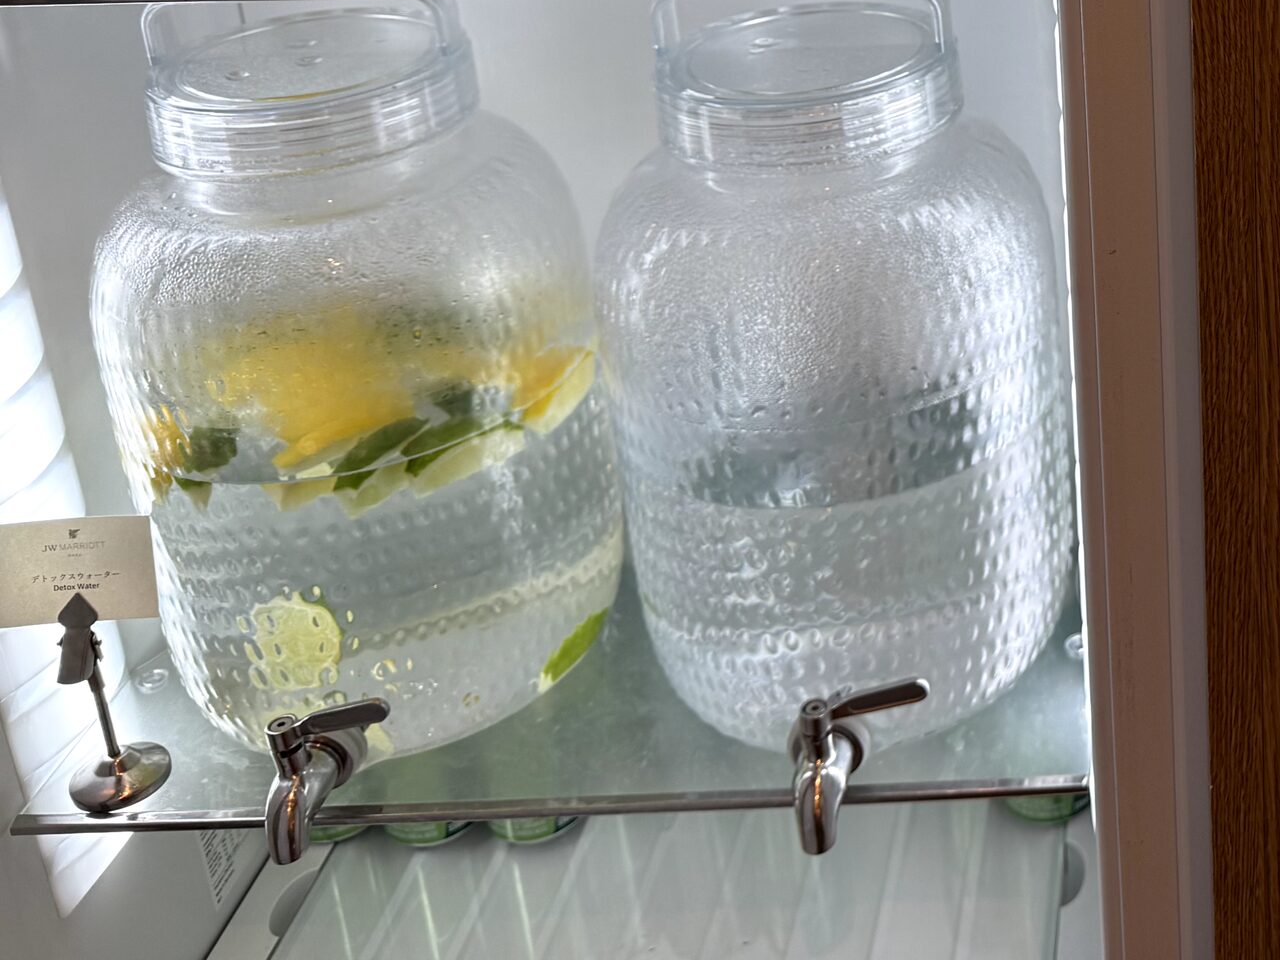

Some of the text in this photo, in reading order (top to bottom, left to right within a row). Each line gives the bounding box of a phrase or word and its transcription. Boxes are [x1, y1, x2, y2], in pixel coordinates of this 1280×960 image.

[42, 540, 106, 553] JW MARRIOTT
[32, 571, 120, 584] デトックスウォーター
[53, 583, 100, 592] Detox Water
